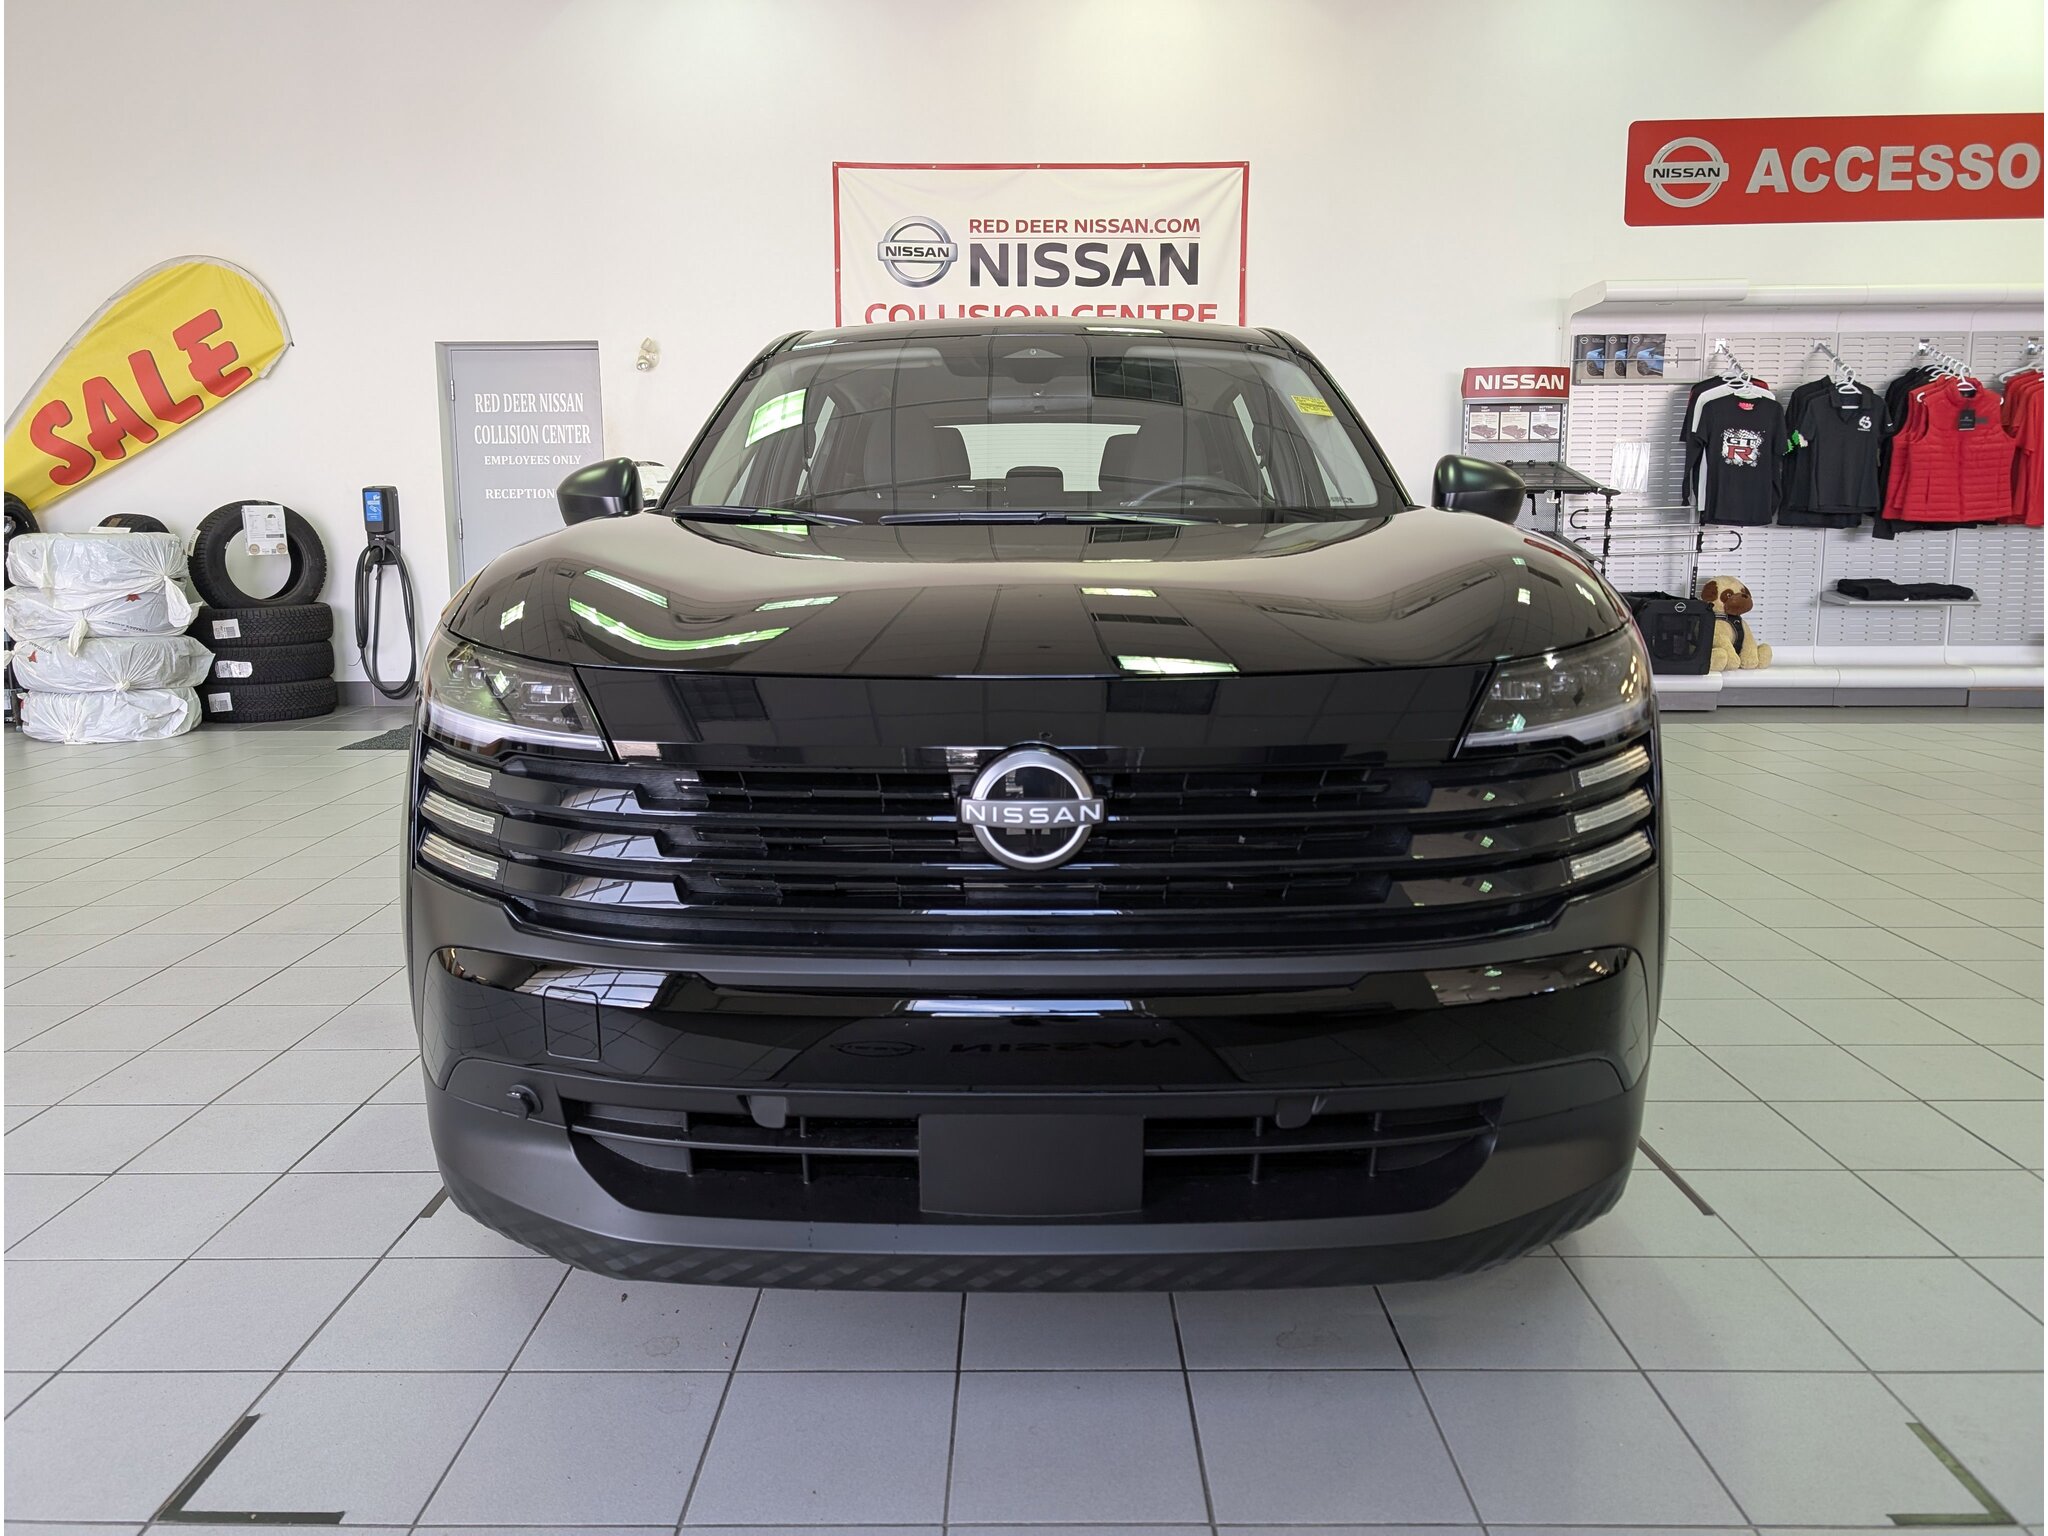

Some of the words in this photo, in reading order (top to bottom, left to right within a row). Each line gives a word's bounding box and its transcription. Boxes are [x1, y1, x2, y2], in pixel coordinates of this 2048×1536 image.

[1652, 166, 1721, 180] NISSAN
[1745, 142, 2041, 194] ACCESSO
[969, 218, 1009, 234] RED
[1015, 218, 1069, 234] DEER
[1074, 218, 1201, 234] NISSAN.COM
[885, 245, 950, 259] NISSAN
[969, 241, 1200, 288] NISSAN
[1474, 374, 1565, 391] NISSAN
[30, 308, 253, 486] SALE
[474, 393, 501, 413] RED
[503, 393, 538, 413] DEER
[539, 392, 584, 413] NISSAN
[474, 424, 539, 445] COLLISION
[542, 424, 592, 444] CENTER
[484, 455, 550, 465] EMPLOYEES
[552, 455, 582, 465] ONLY
[485, 488, 556, 499] RECEPTION
[965, 803, 1101, 824] NISSAN
